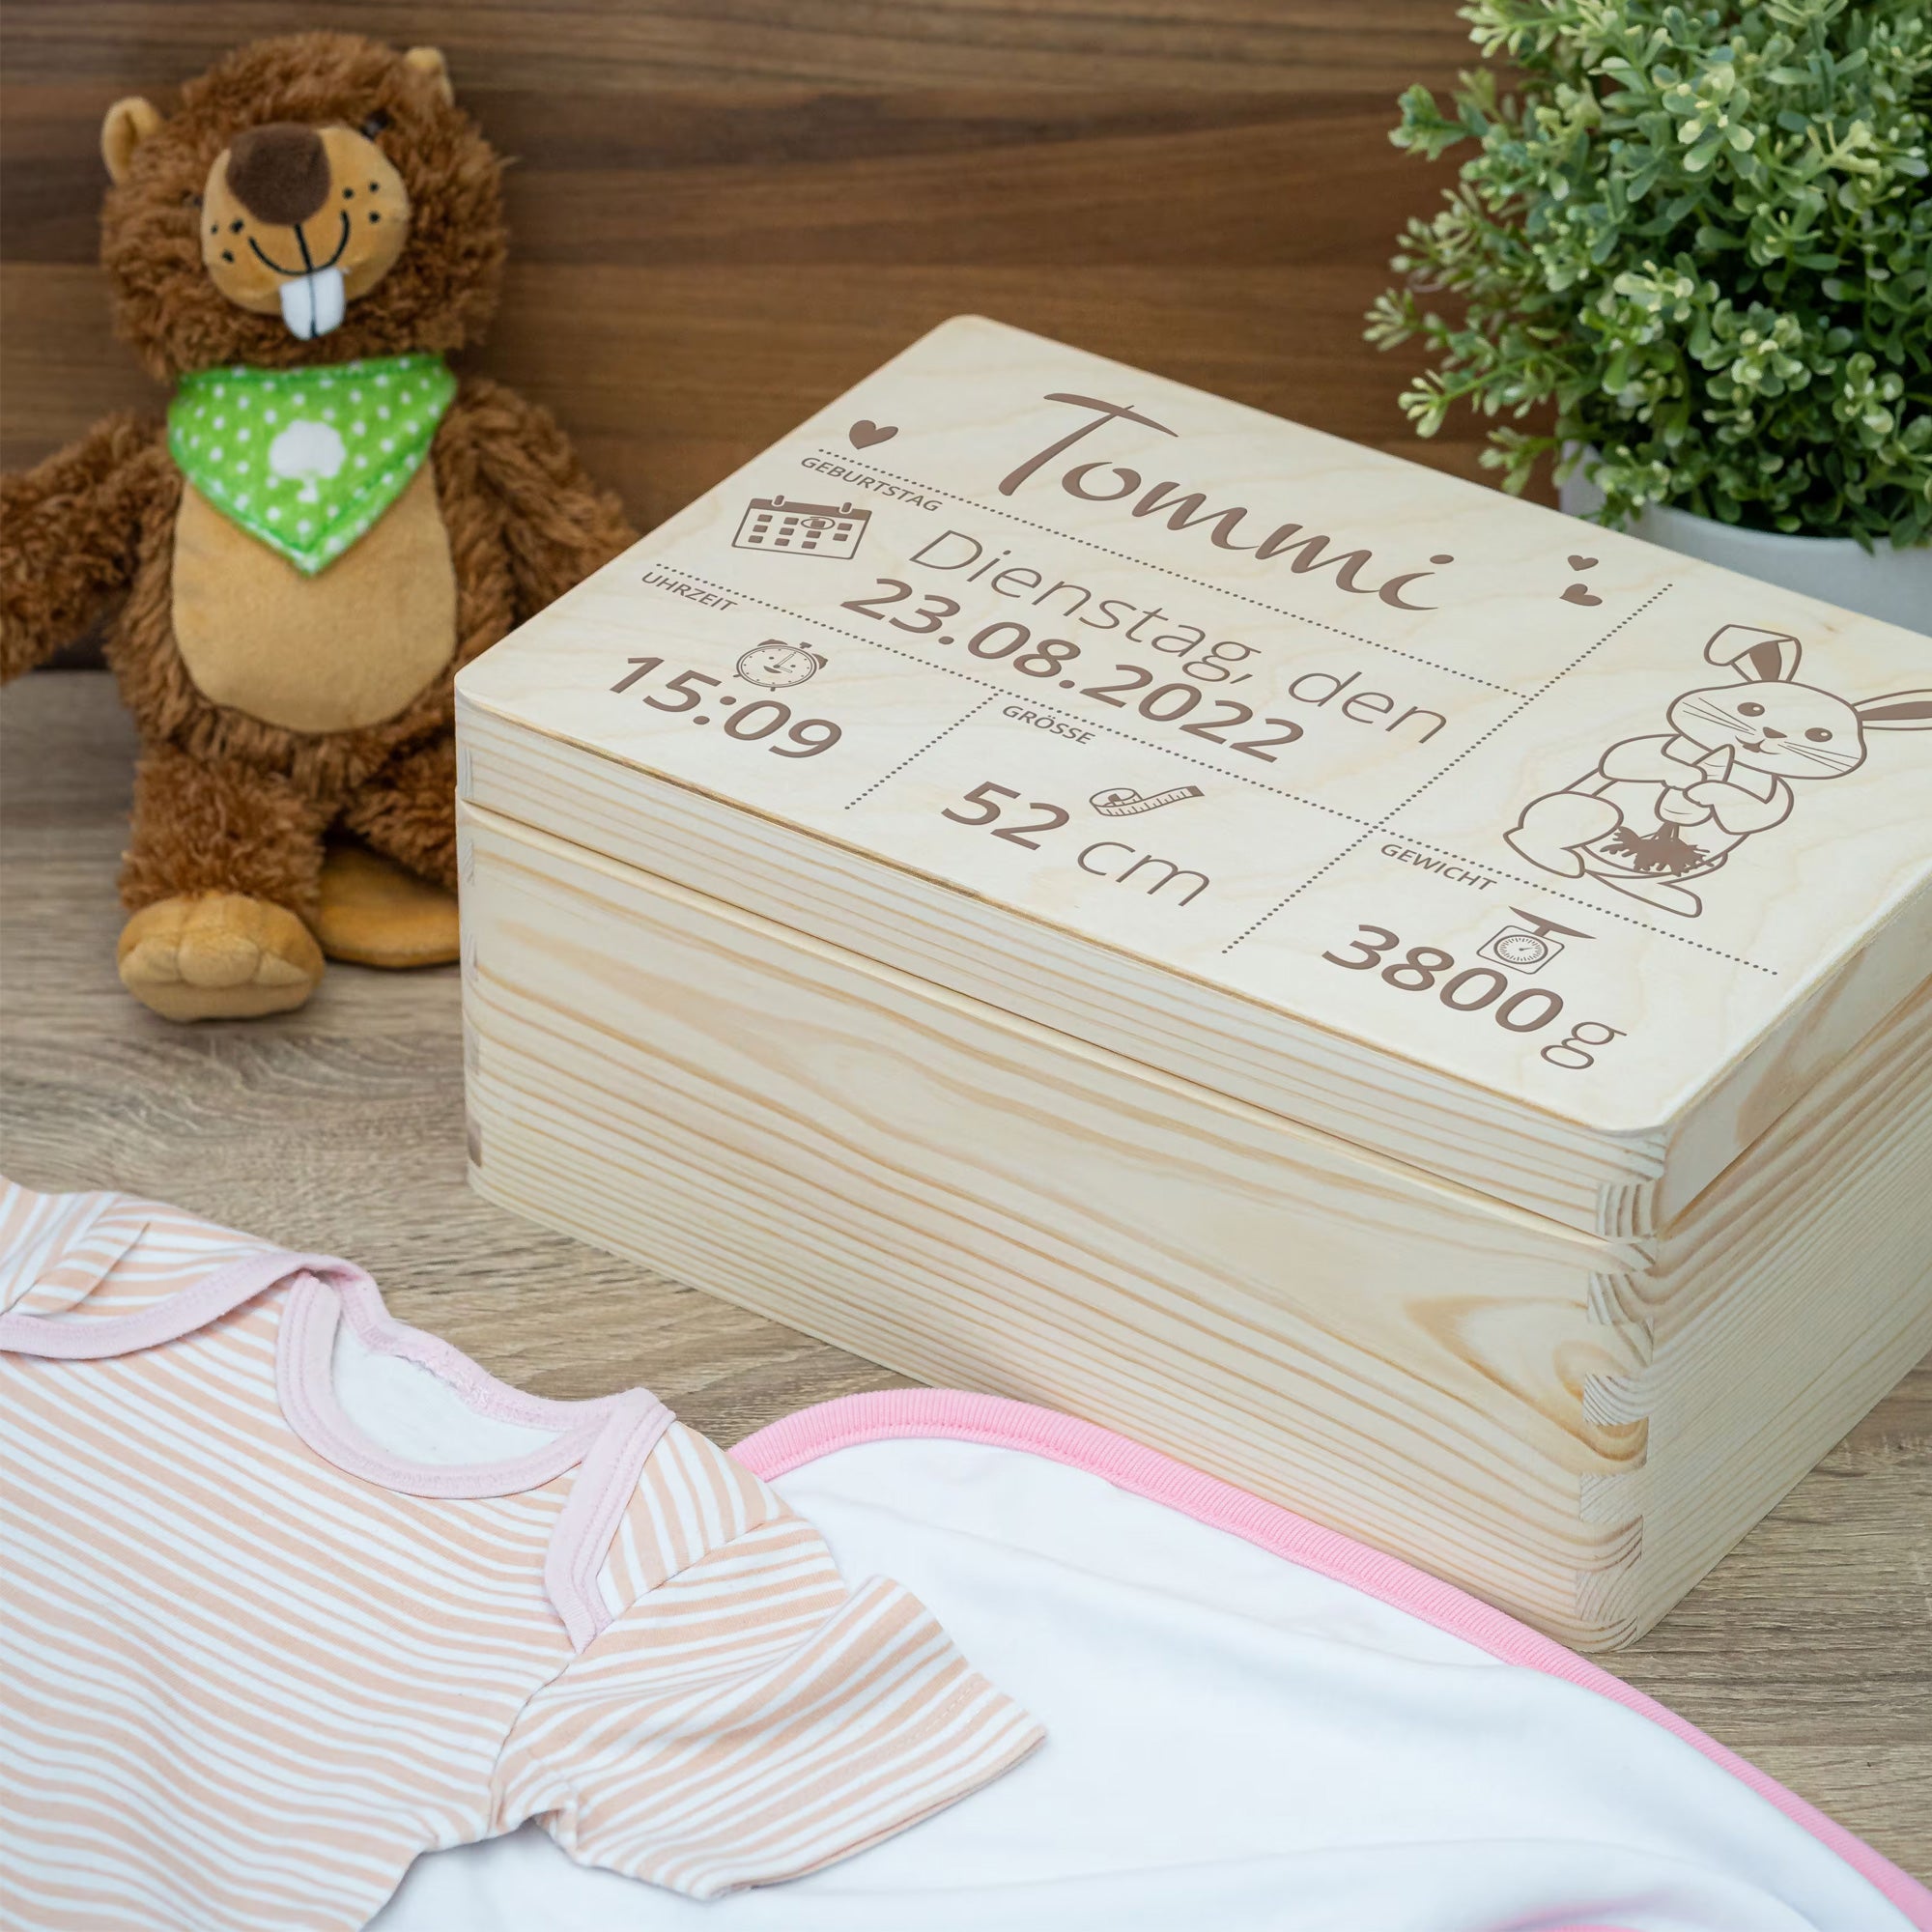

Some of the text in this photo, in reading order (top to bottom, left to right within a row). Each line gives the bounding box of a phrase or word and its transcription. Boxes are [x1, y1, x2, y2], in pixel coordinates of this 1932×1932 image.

[800, 456, 943, 512] GEBURTSTAG
[998, 392, 1455, 611] Tommi
[640, 571, 738, 611] UHRZEIT
[908, 529, 1447, 745] Dienstag, den
[609, 656, 842, 759] 15:09
[839, 578, 1304, 764] 23.08.2022
[1002, 704, 1095, 745] GRÖSSE
[940, 781, 1210, 907] 52 cm
[1380, 843, 1498, 891] GEWICHT
